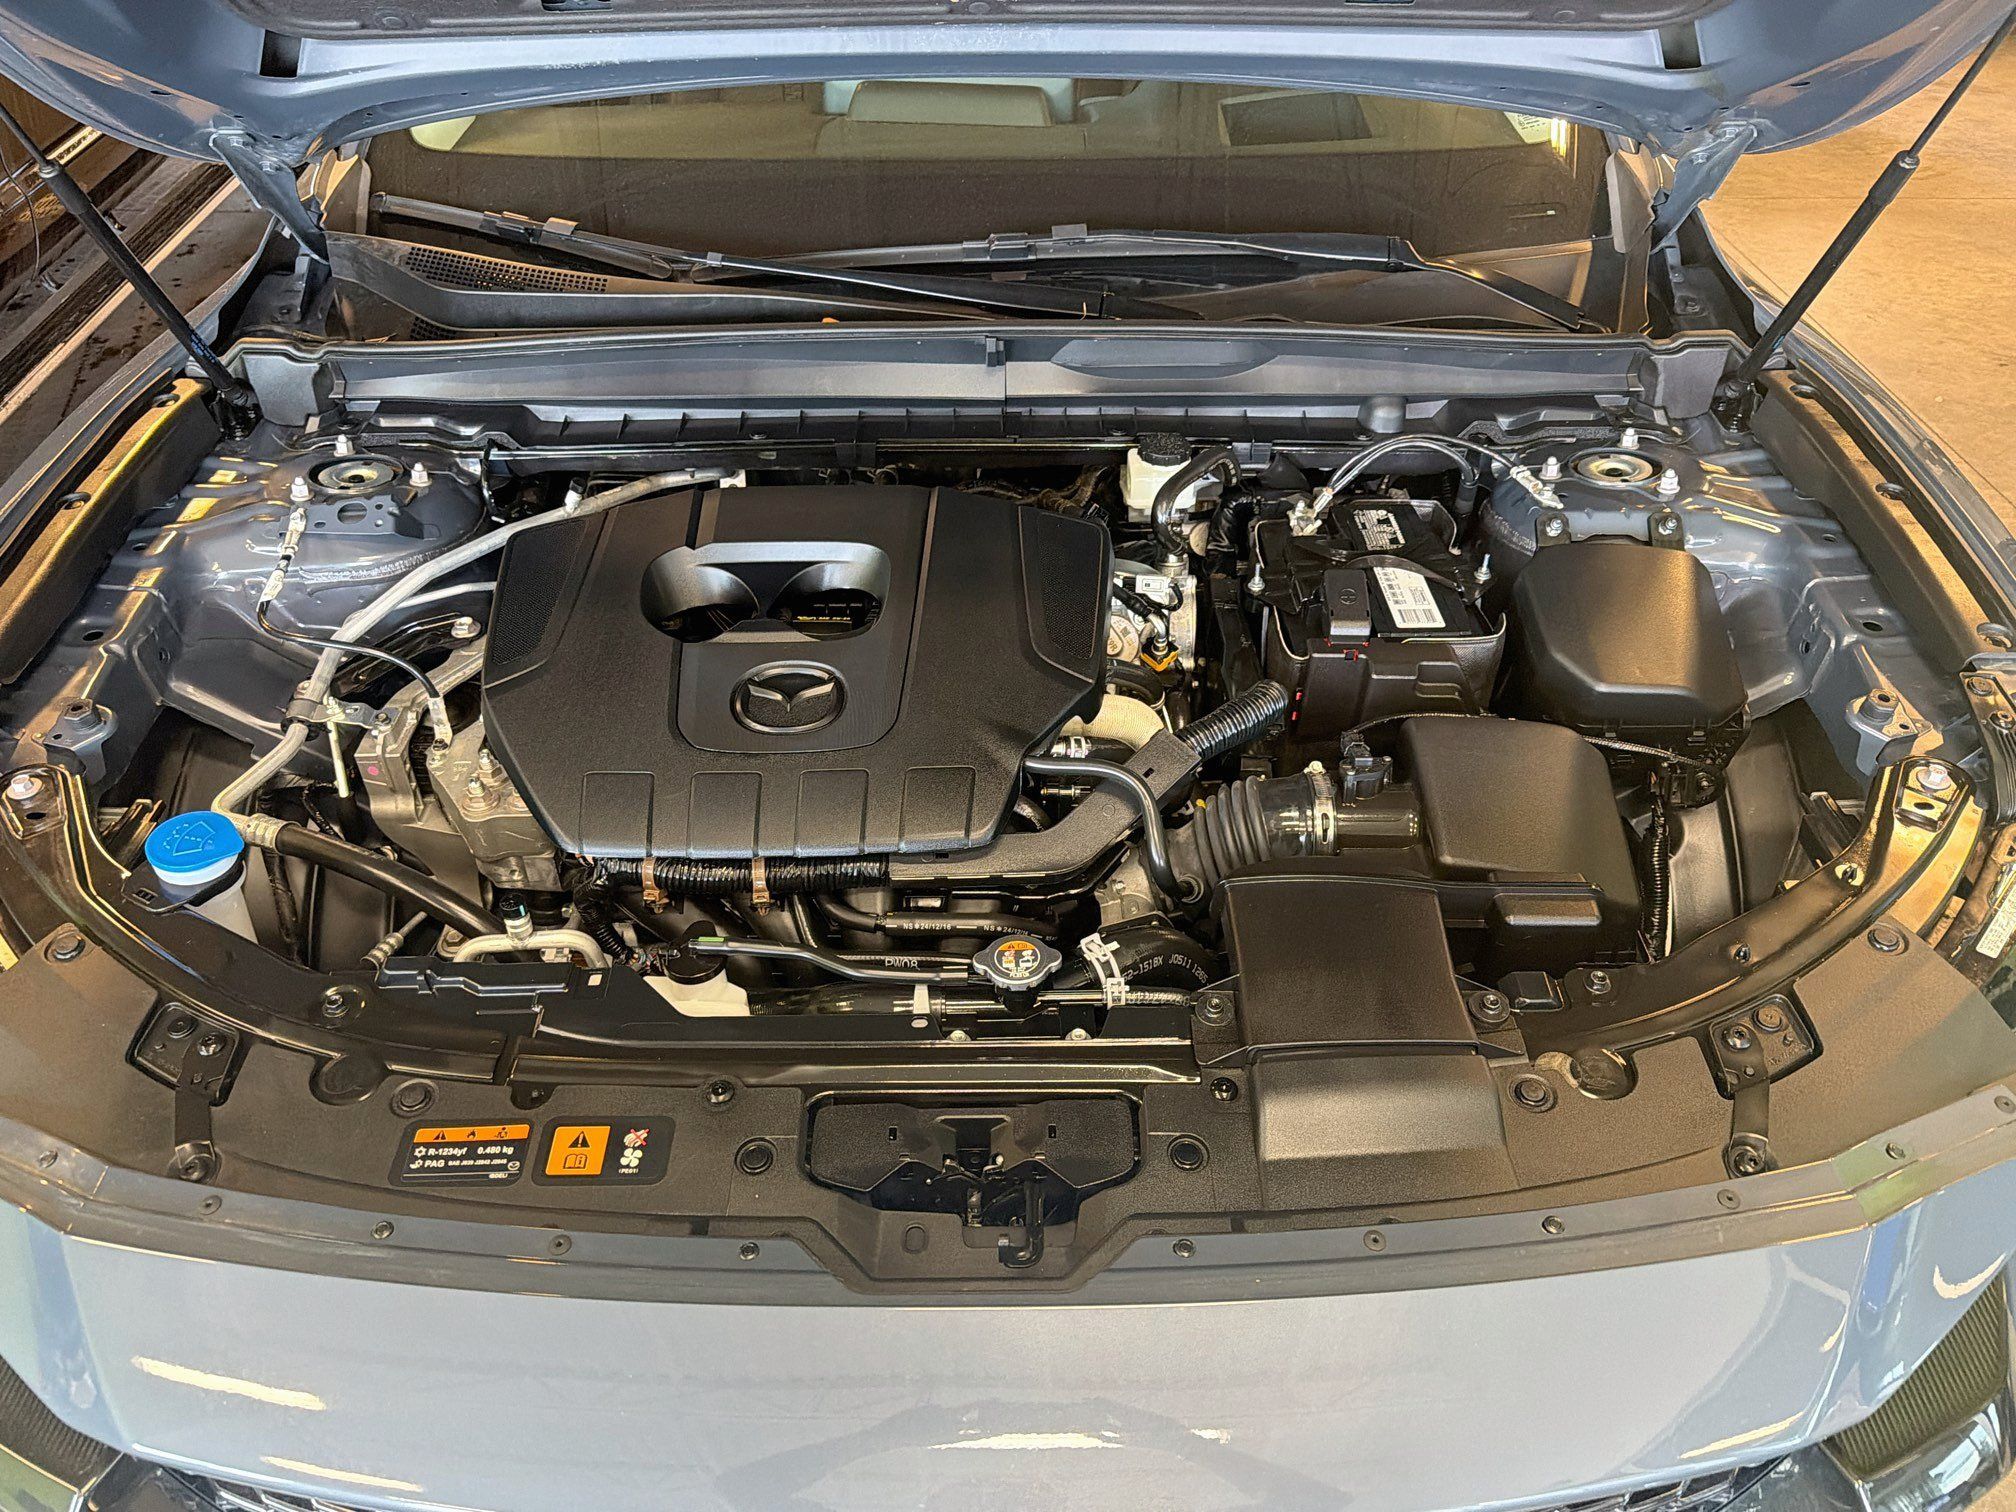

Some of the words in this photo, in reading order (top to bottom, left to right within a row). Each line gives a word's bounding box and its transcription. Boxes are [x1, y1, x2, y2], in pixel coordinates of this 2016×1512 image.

[427, 1147, 468, 1156] R-1234yf
[477, 1146, 501, 1154] 0.480
[502, 1145, 514, 1155] kg
[424, 1159, 445, 1168] PAG
